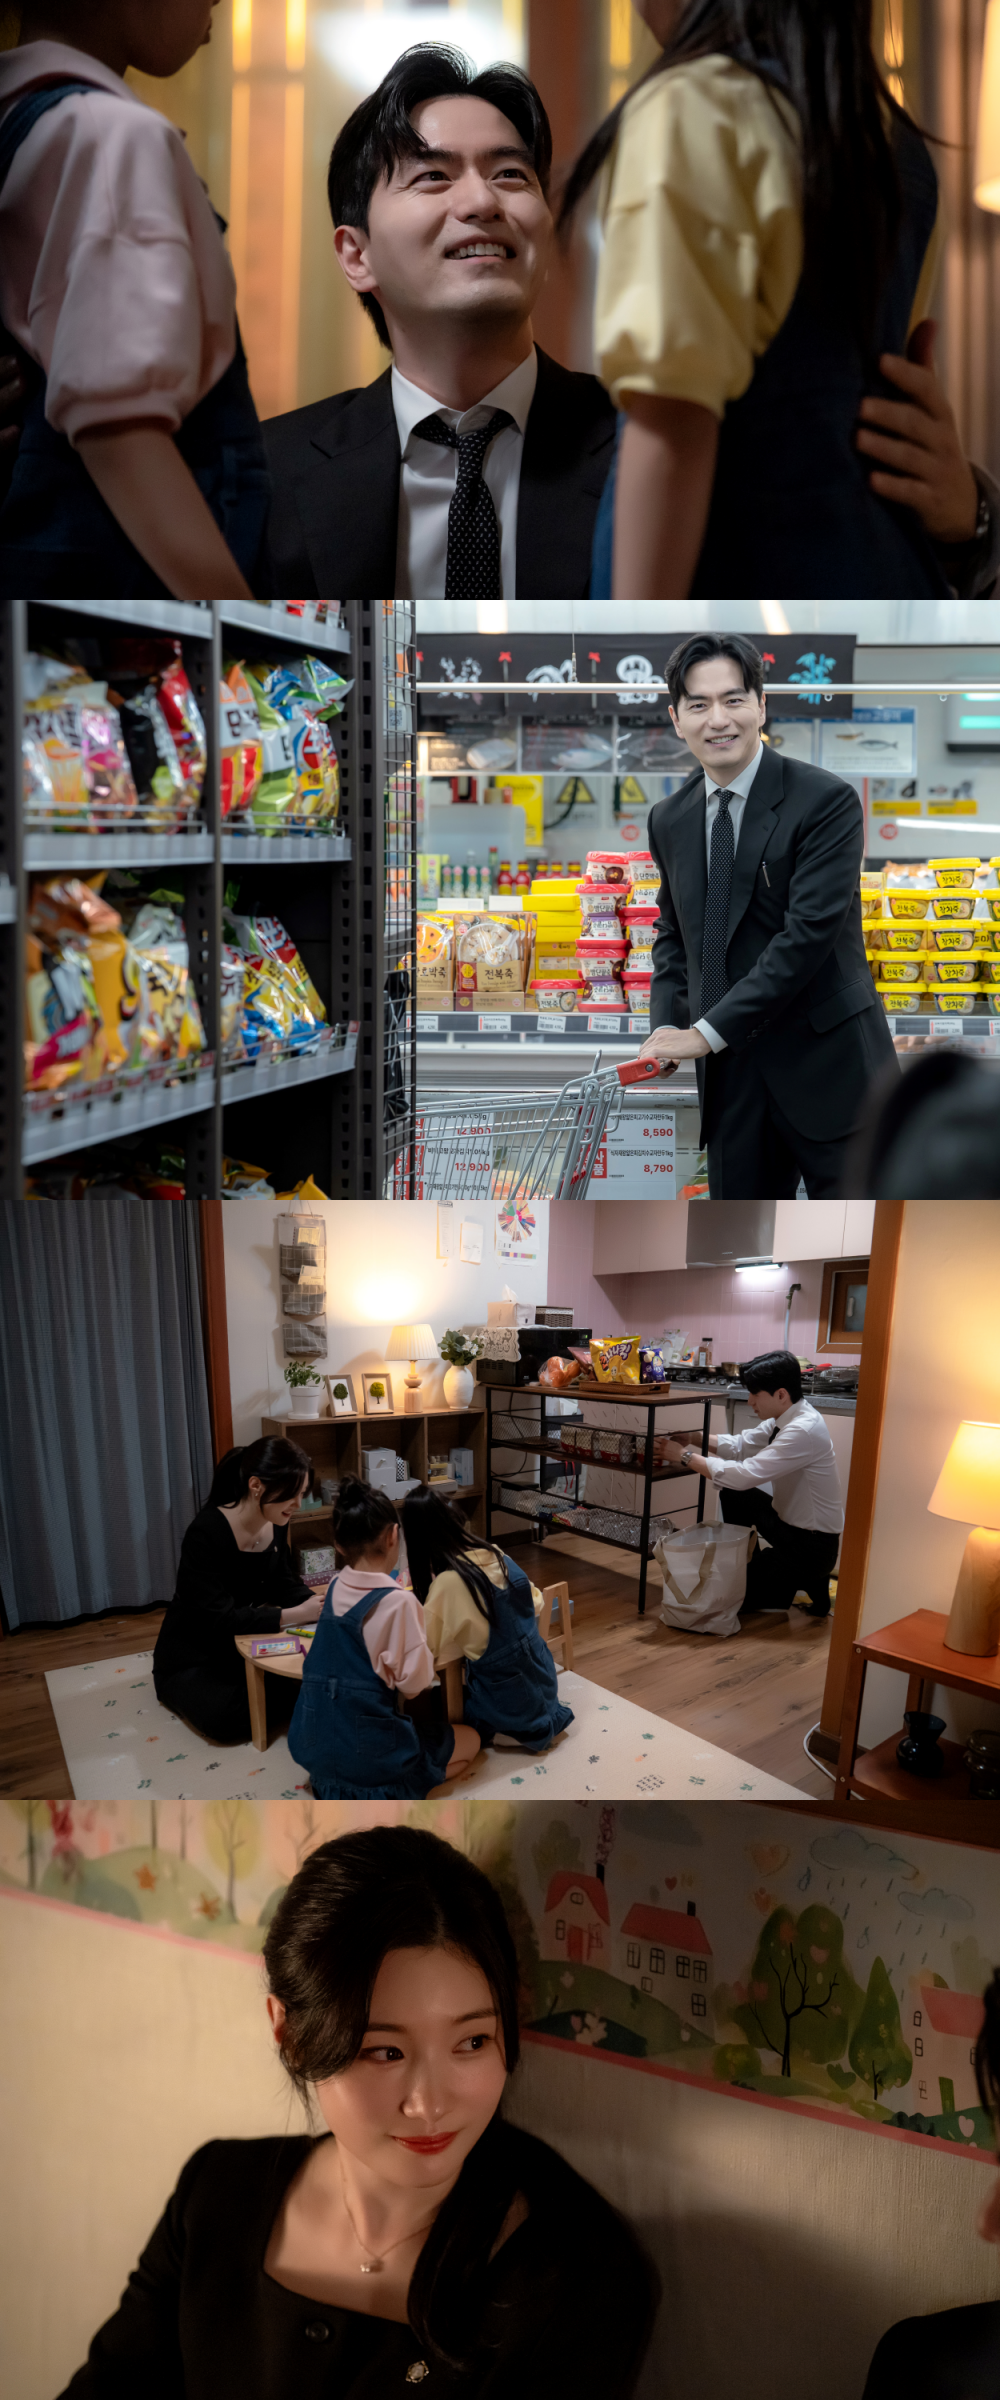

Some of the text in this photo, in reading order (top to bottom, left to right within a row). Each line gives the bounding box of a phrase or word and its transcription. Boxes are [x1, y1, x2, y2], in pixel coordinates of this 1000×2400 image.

[484, 968, 514, 980] 전복죽
[643, 1128, 674, 1139] 8,590
[643, 1164, 674, 1175] 8,790
